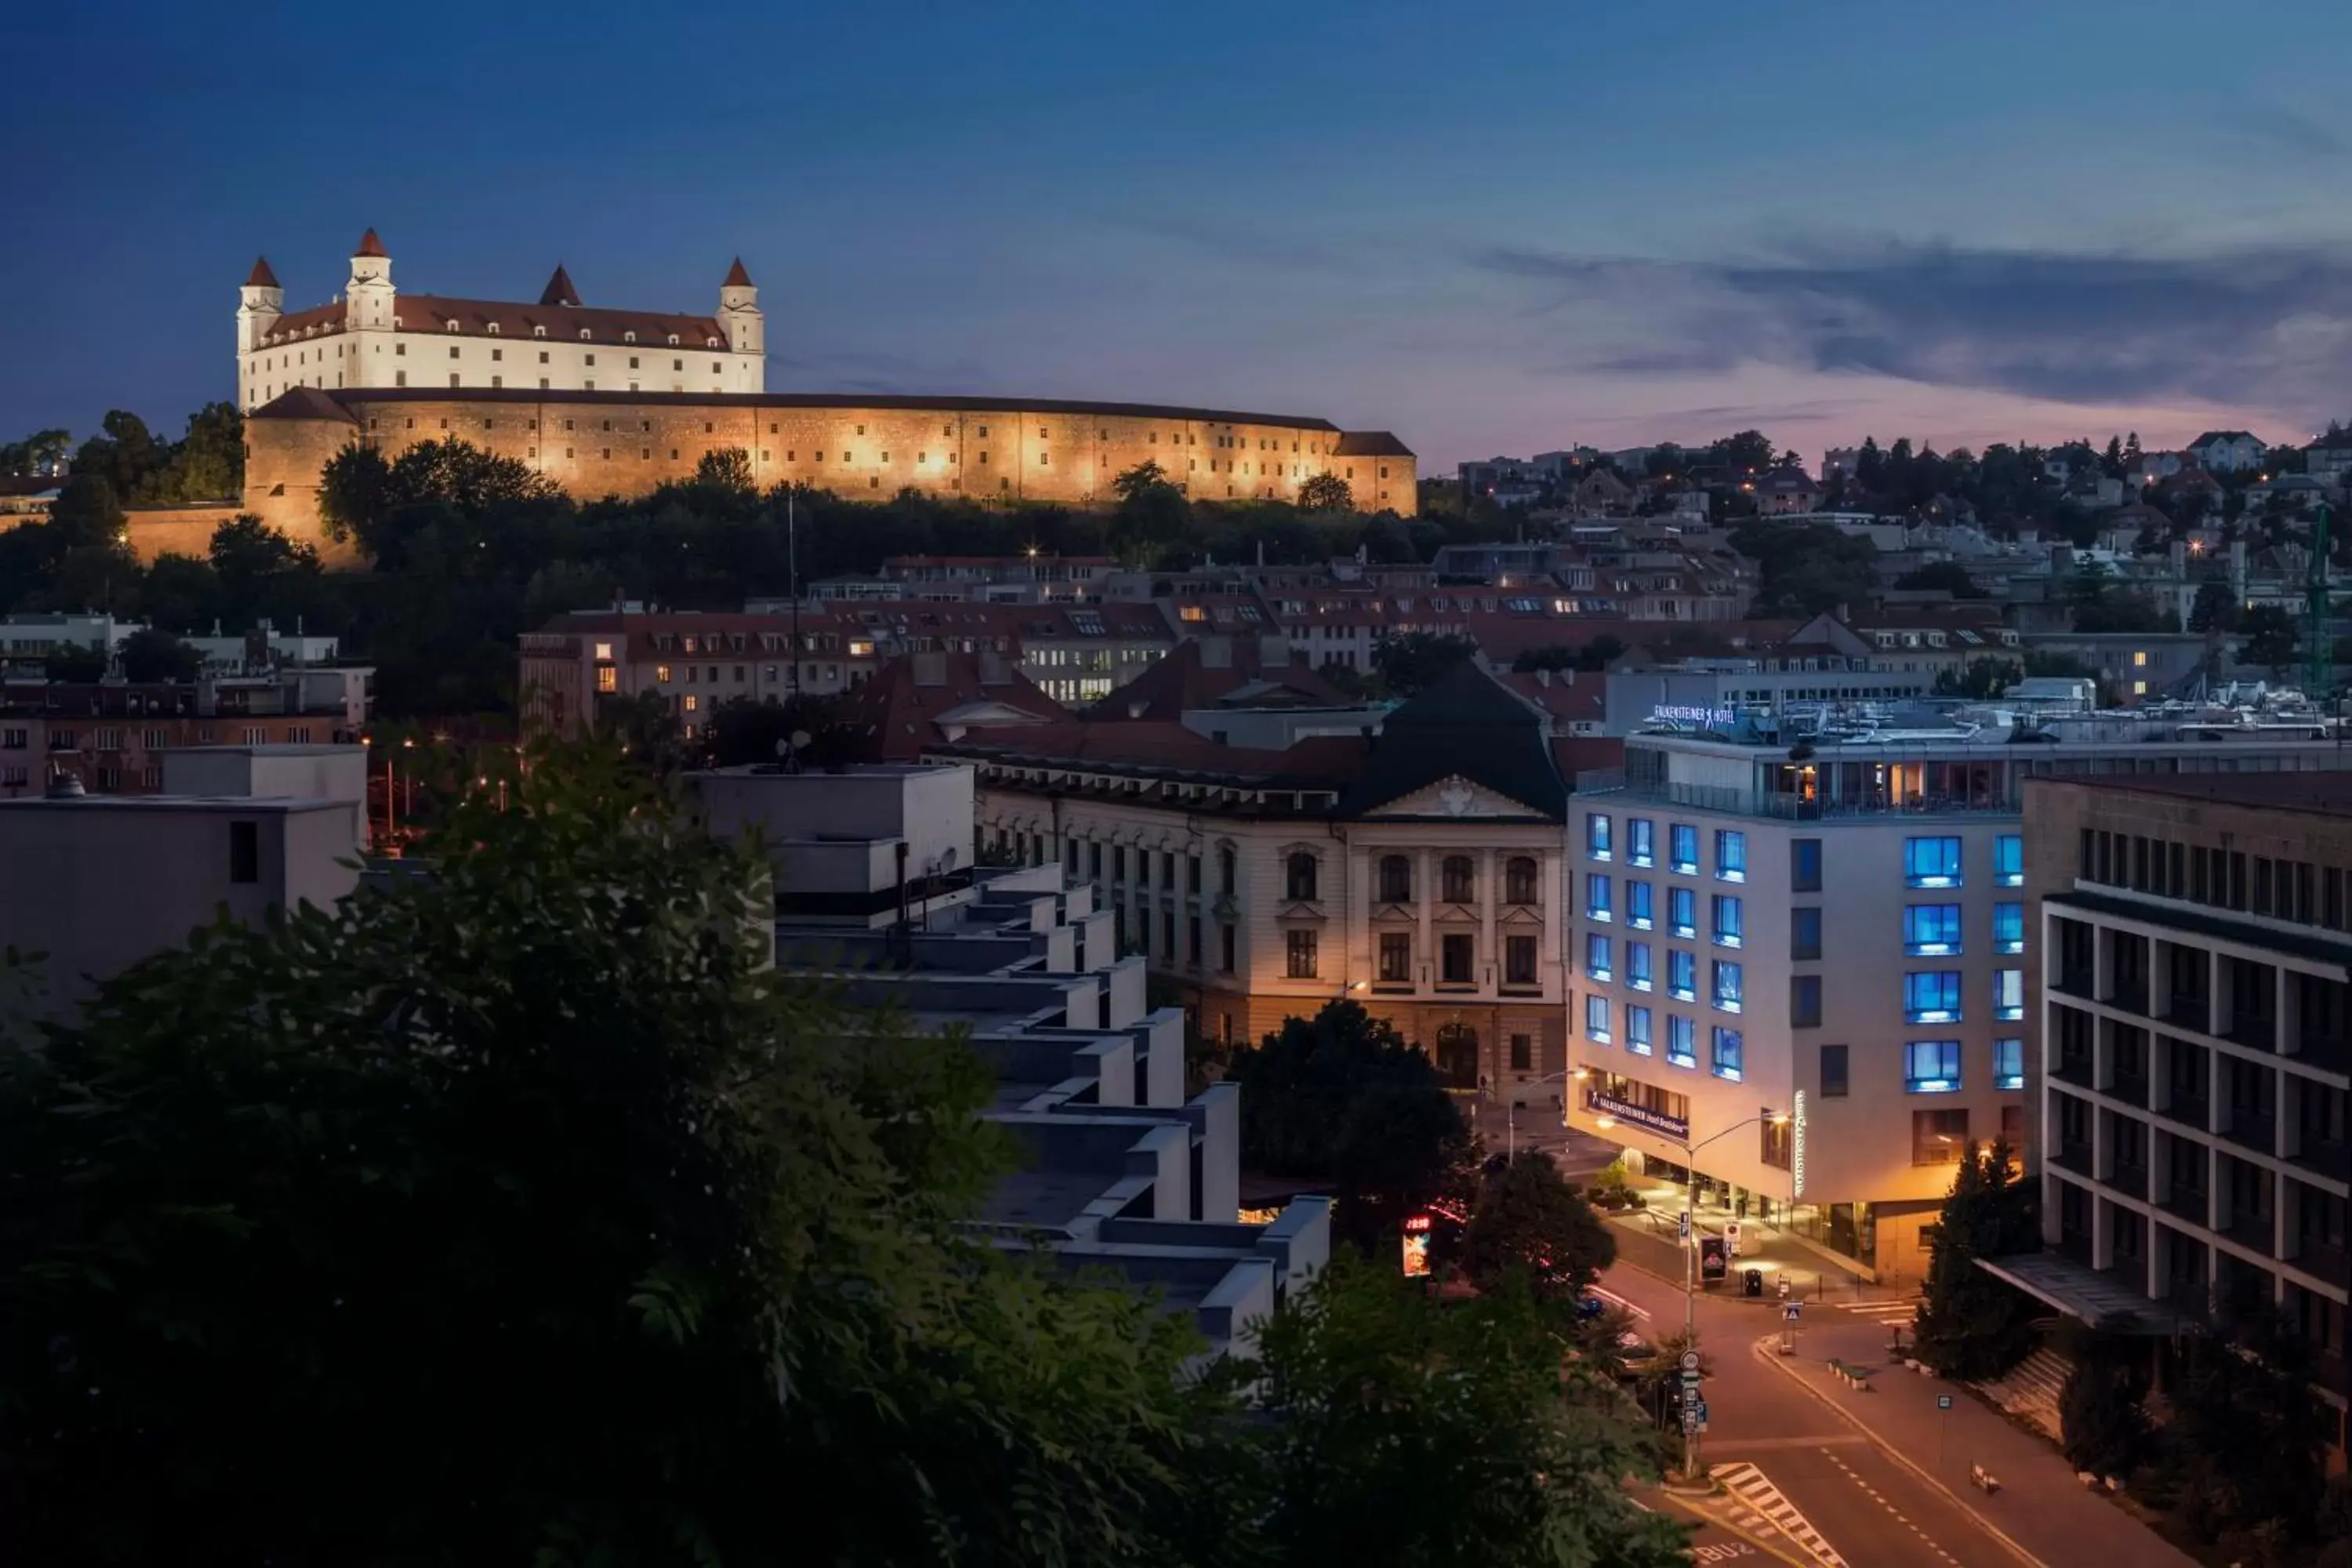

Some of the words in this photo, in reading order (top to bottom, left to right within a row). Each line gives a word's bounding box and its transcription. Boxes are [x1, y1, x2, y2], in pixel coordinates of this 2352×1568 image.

[1654, 705, 1705, 720] FALKENSTEINER
[1713, 709, 1735, 724] HOTEL
[1599, 1097, 1646, 1120] FALKENSTEINER
